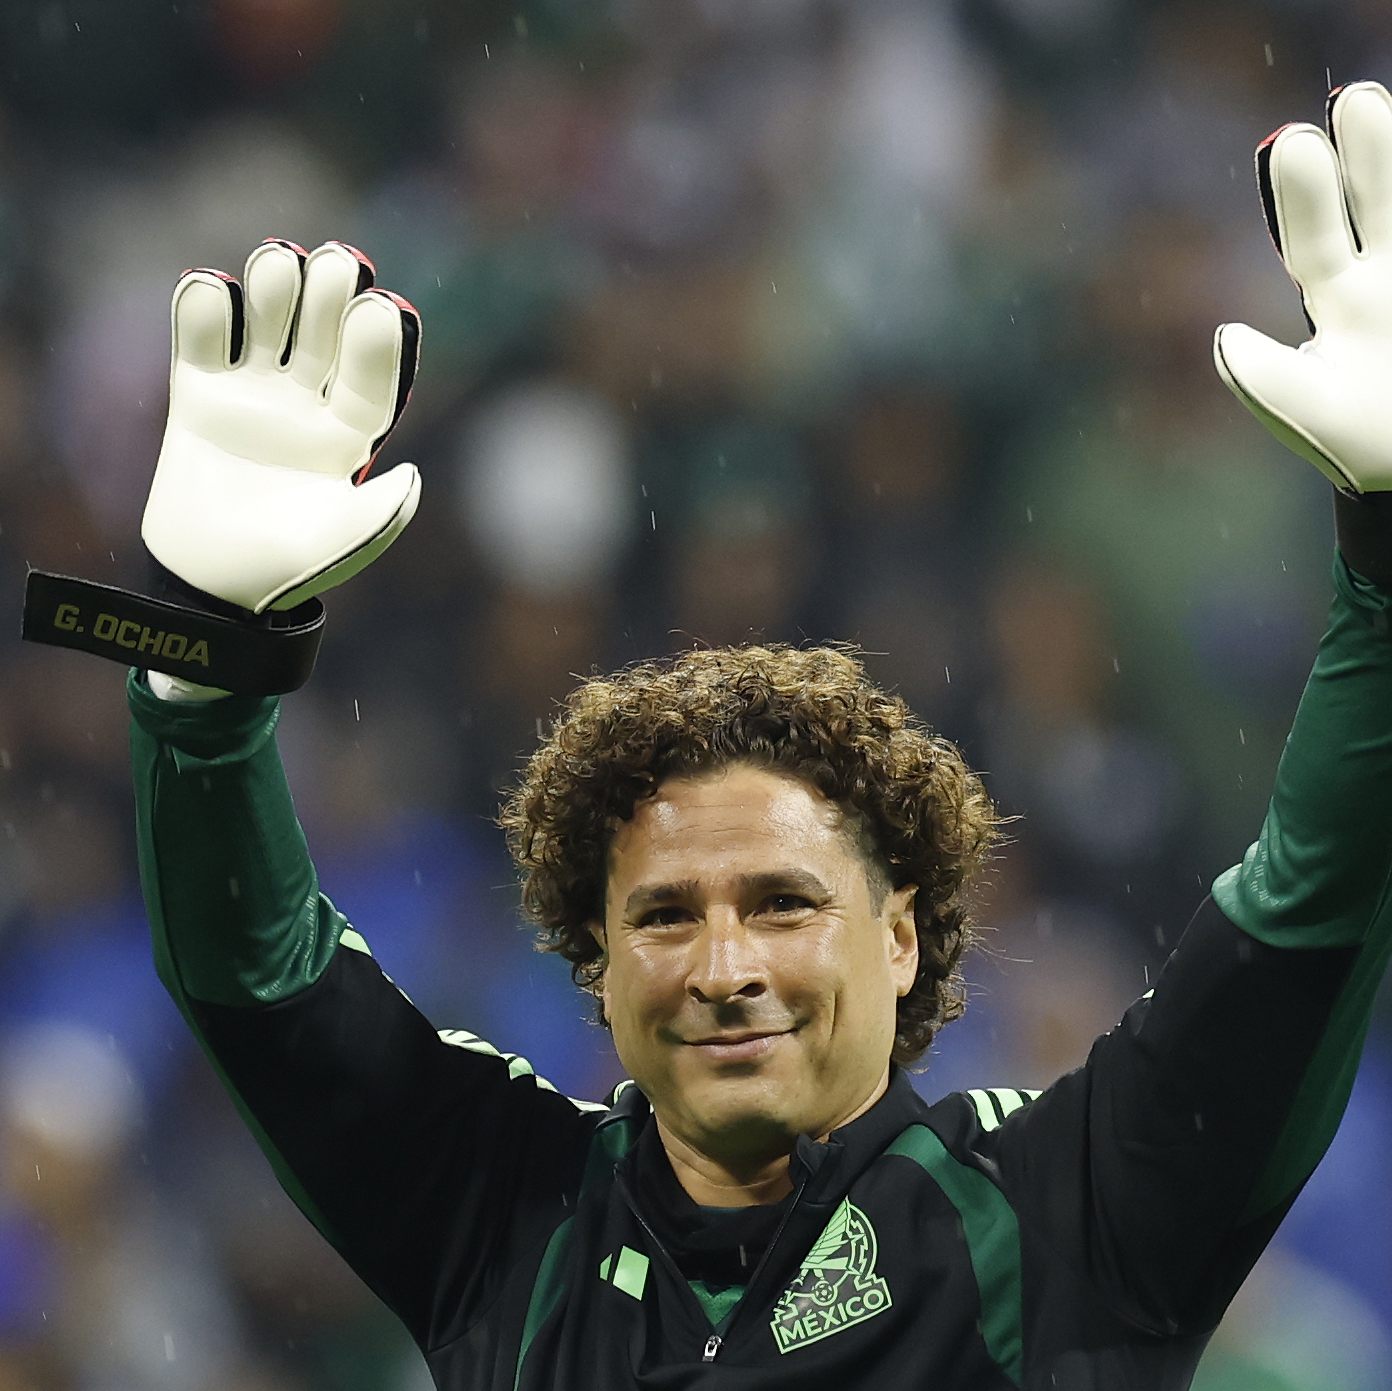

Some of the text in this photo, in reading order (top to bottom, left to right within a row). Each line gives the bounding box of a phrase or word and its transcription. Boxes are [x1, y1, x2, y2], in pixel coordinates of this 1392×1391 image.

[53, 602, 209, 667] G. OCHOA
[778, 1289, 885, 1346] MÉXICO
